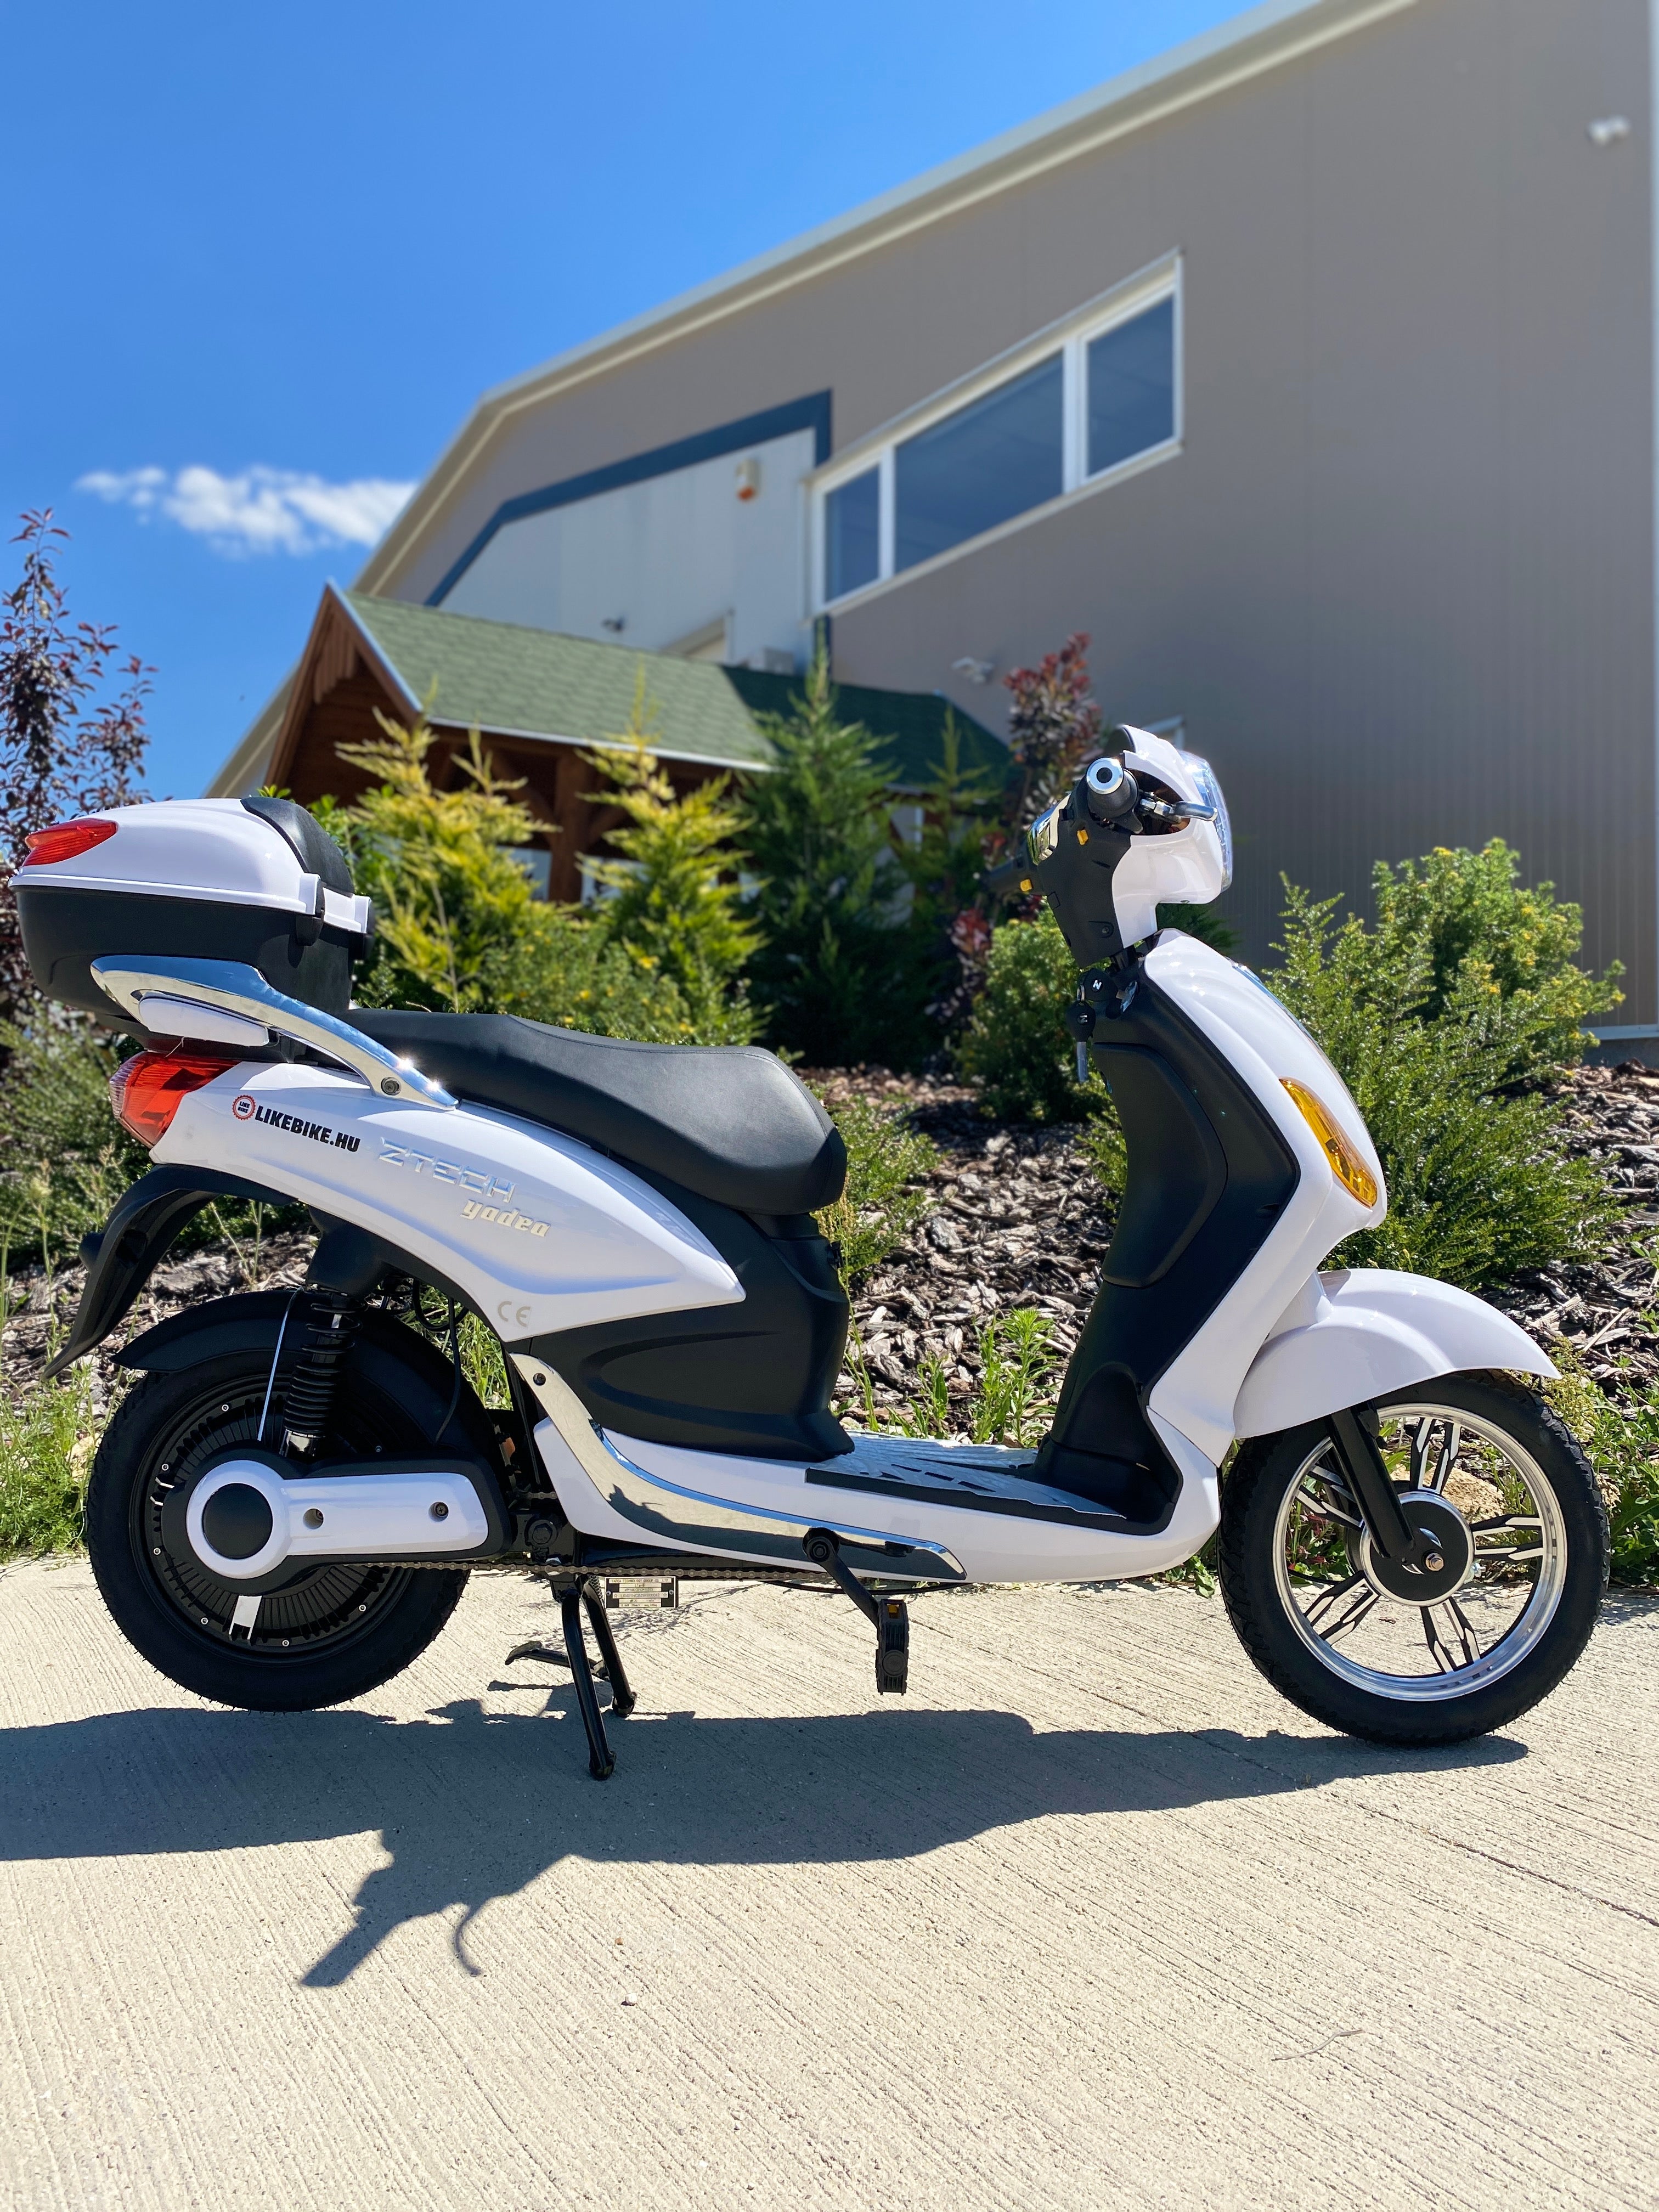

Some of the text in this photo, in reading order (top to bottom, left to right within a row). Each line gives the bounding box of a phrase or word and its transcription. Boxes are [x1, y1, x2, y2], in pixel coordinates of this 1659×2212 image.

[255, 1105, 361, 1152] LIKEBIKE.HU
[379, 1137, 516, 1203] ZTECH
[498, 1301, 531, 1327] CE
